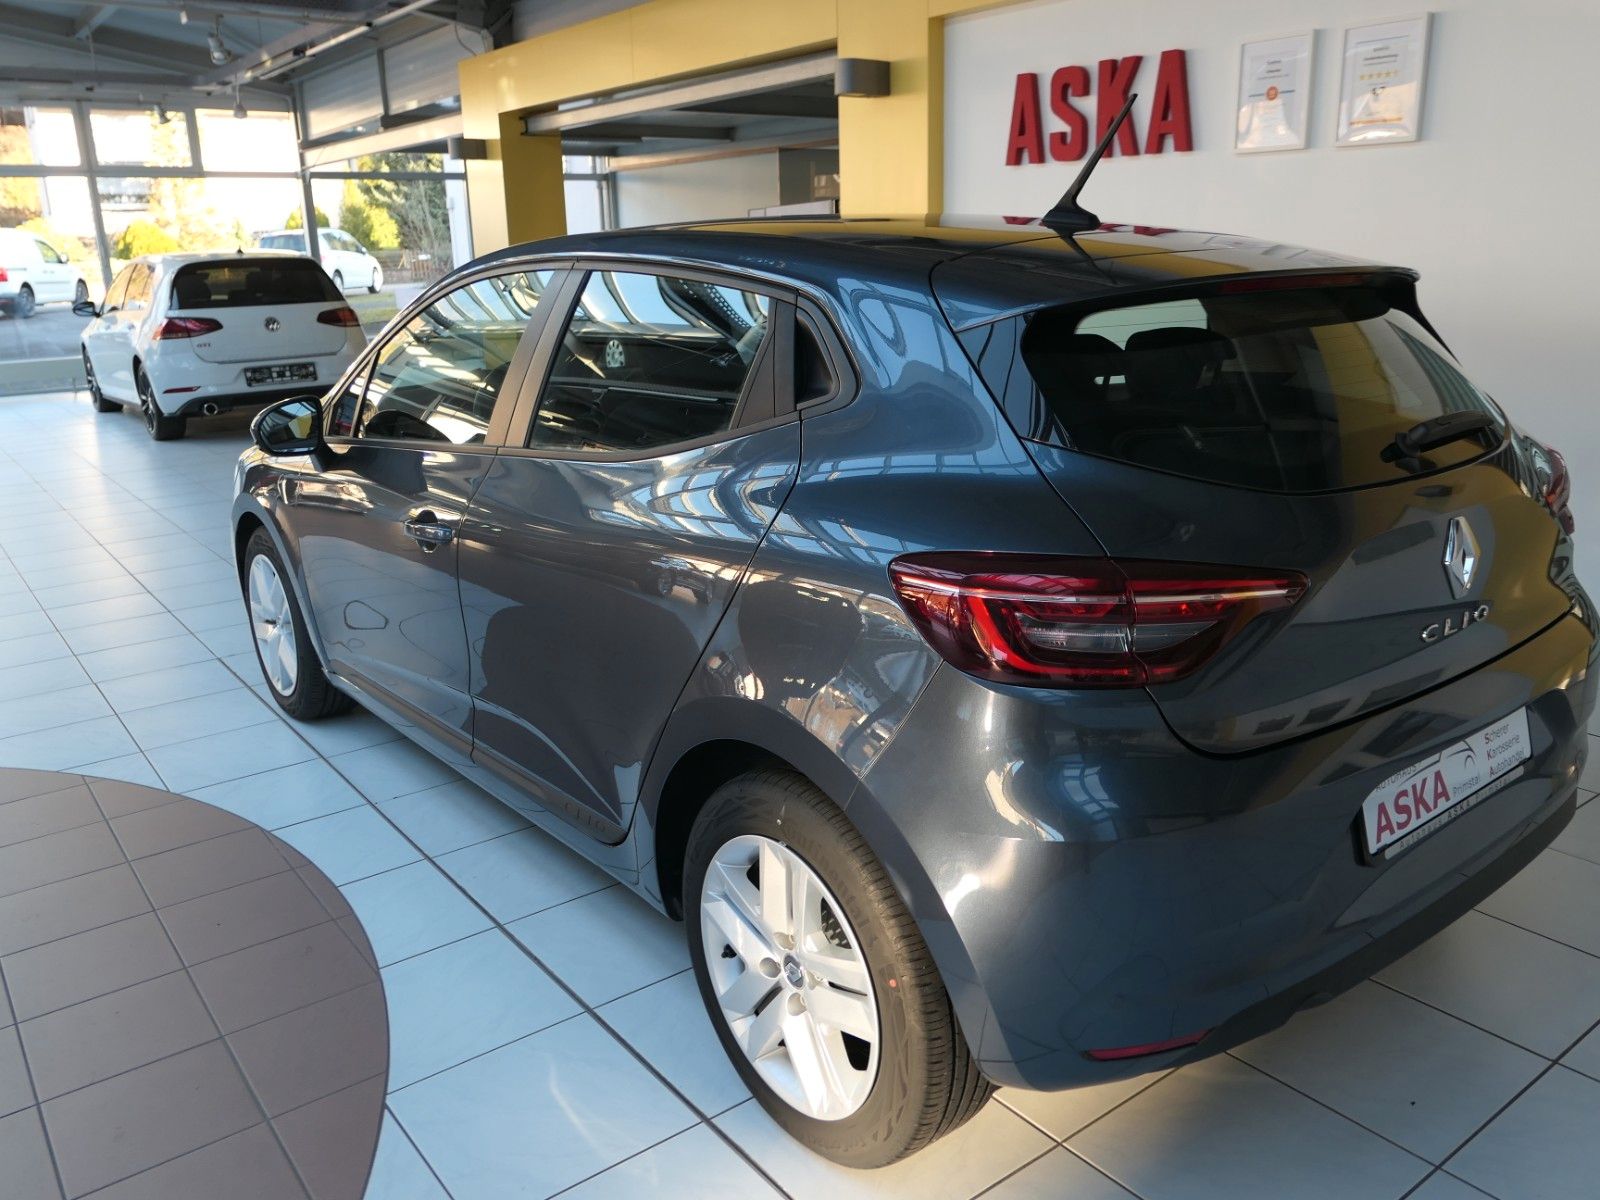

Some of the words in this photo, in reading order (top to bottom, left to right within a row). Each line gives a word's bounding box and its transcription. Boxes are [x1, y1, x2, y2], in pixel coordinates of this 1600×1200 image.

[1005, 48, 1194, 166] ASKA
[1421, 604, 1490, 643] CLIO
[1375, 769, 1451, 844] ASKA
